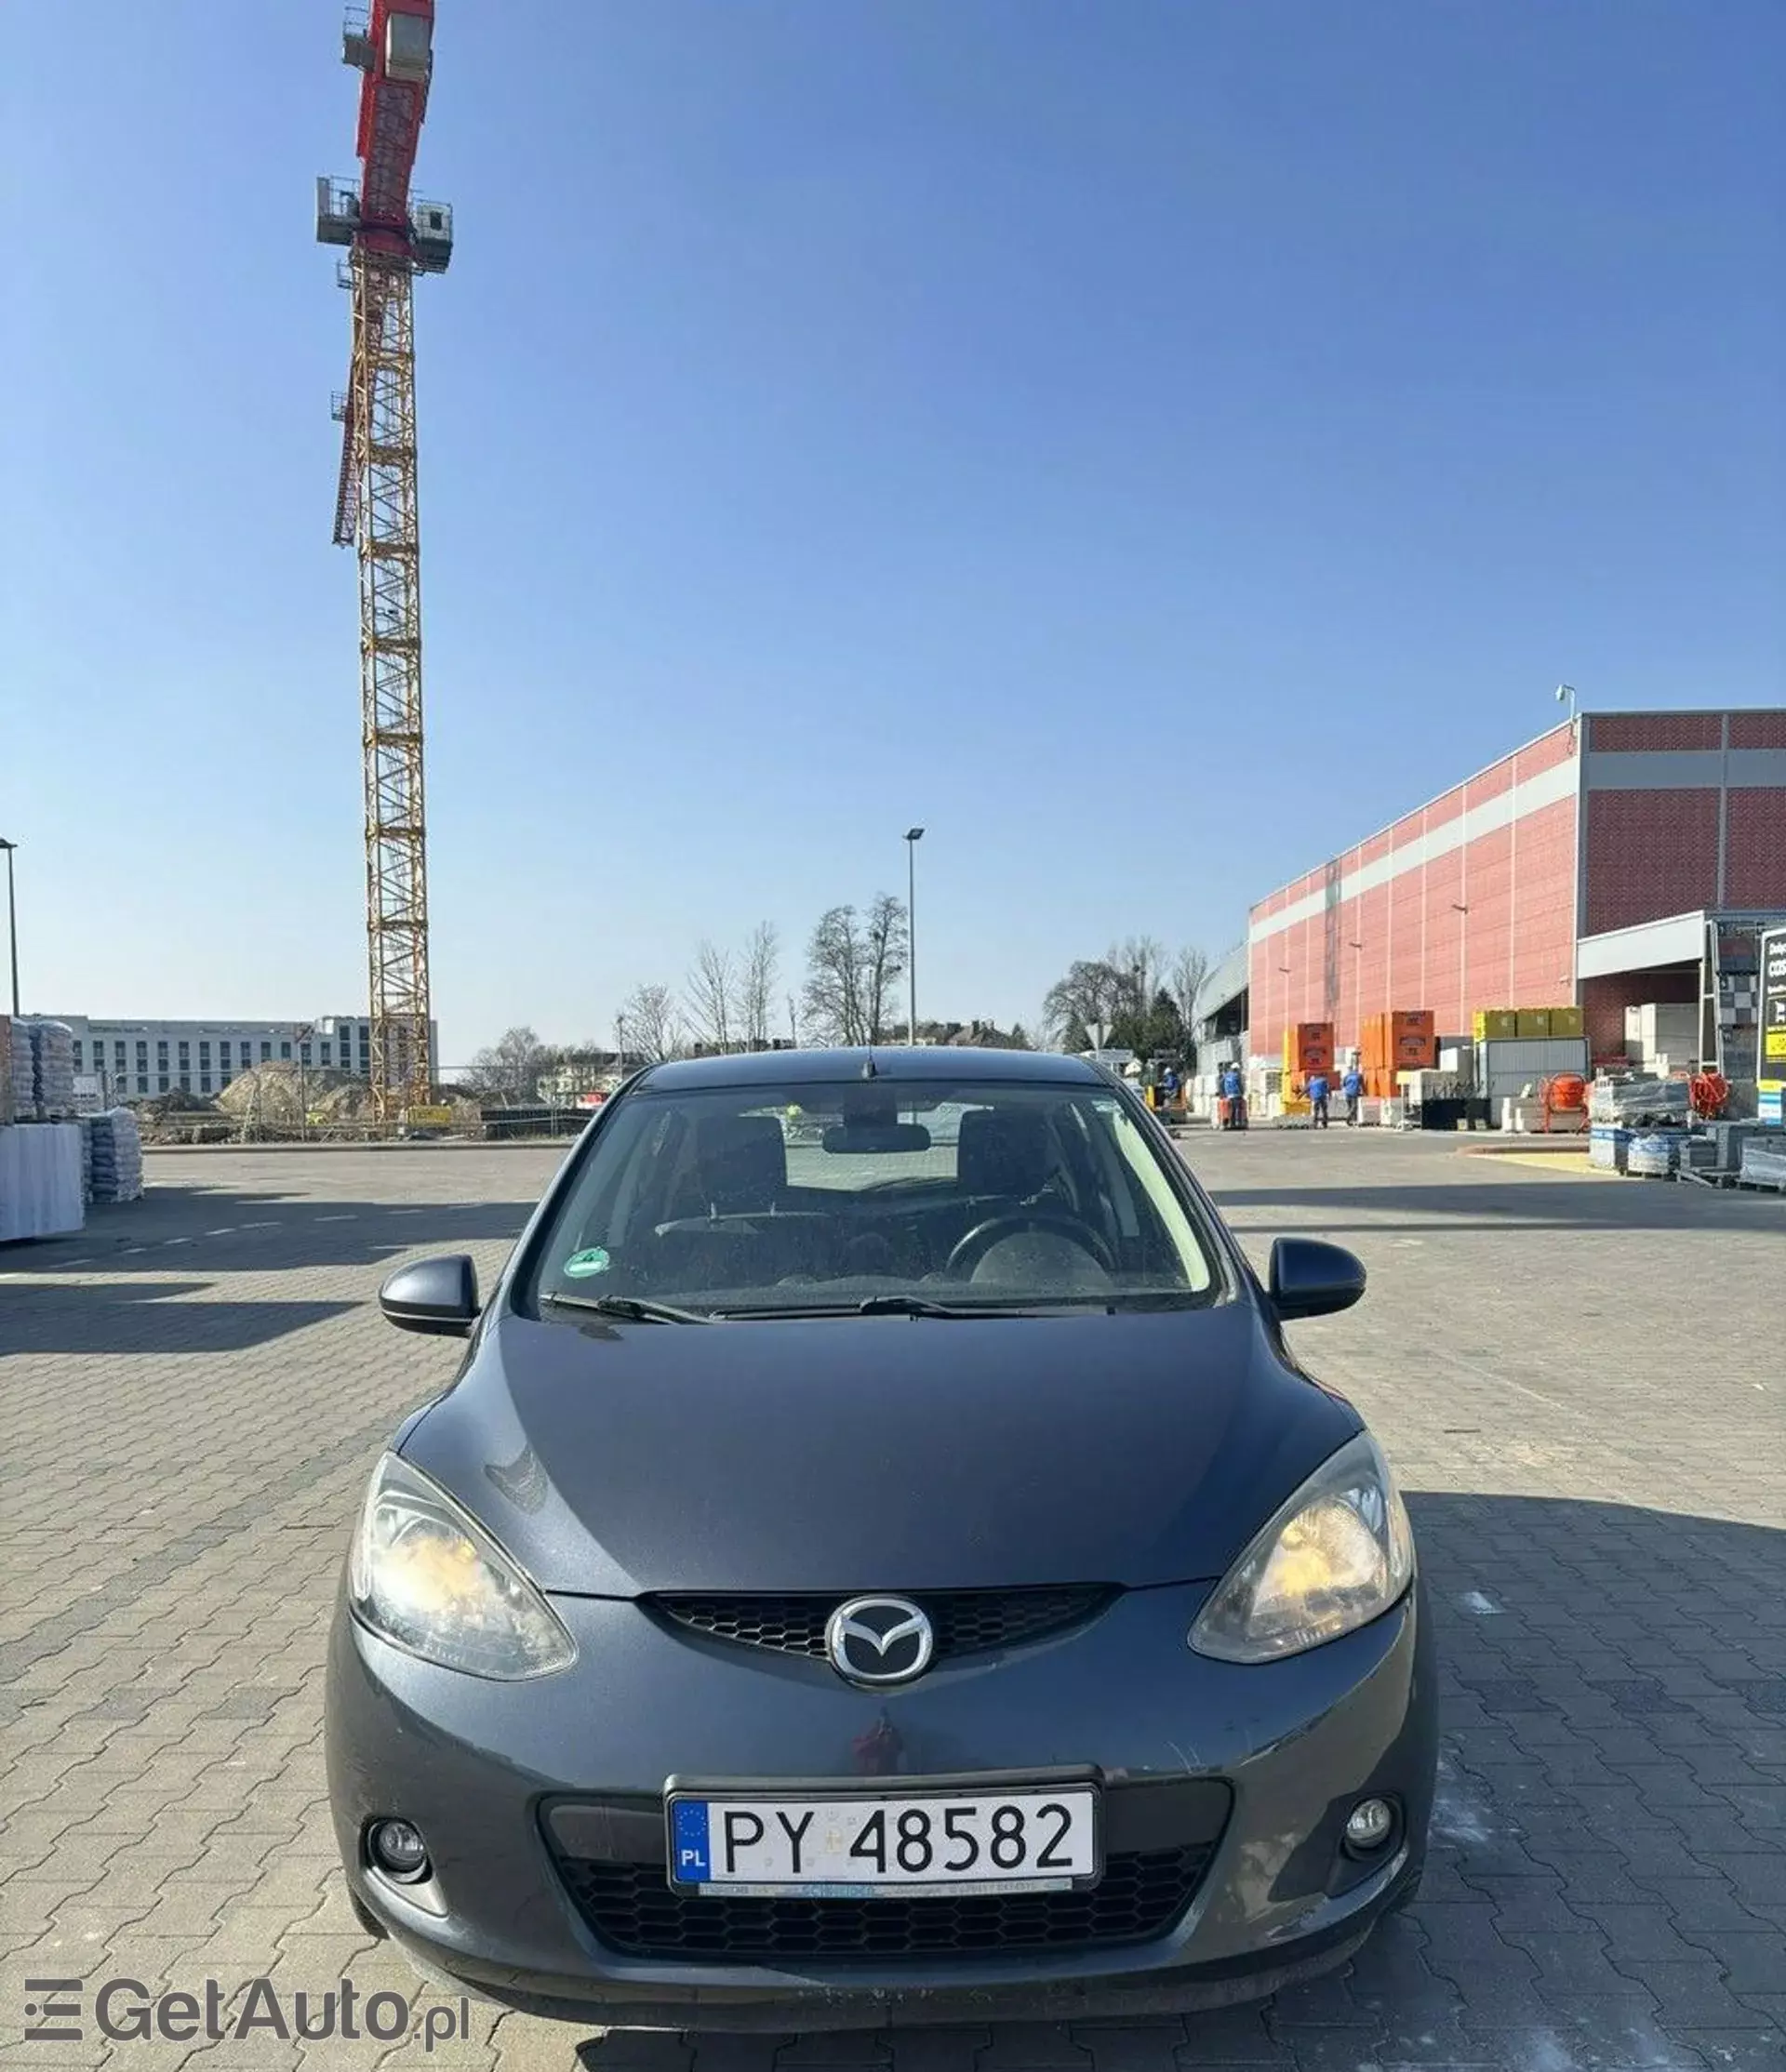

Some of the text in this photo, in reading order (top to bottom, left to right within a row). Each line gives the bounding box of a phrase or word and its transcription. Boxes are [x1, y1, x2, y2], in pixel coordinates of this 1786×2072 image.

[681, 1849, 706, 1867] PL
[724, 1803, 1073, 1874] PY 48582
